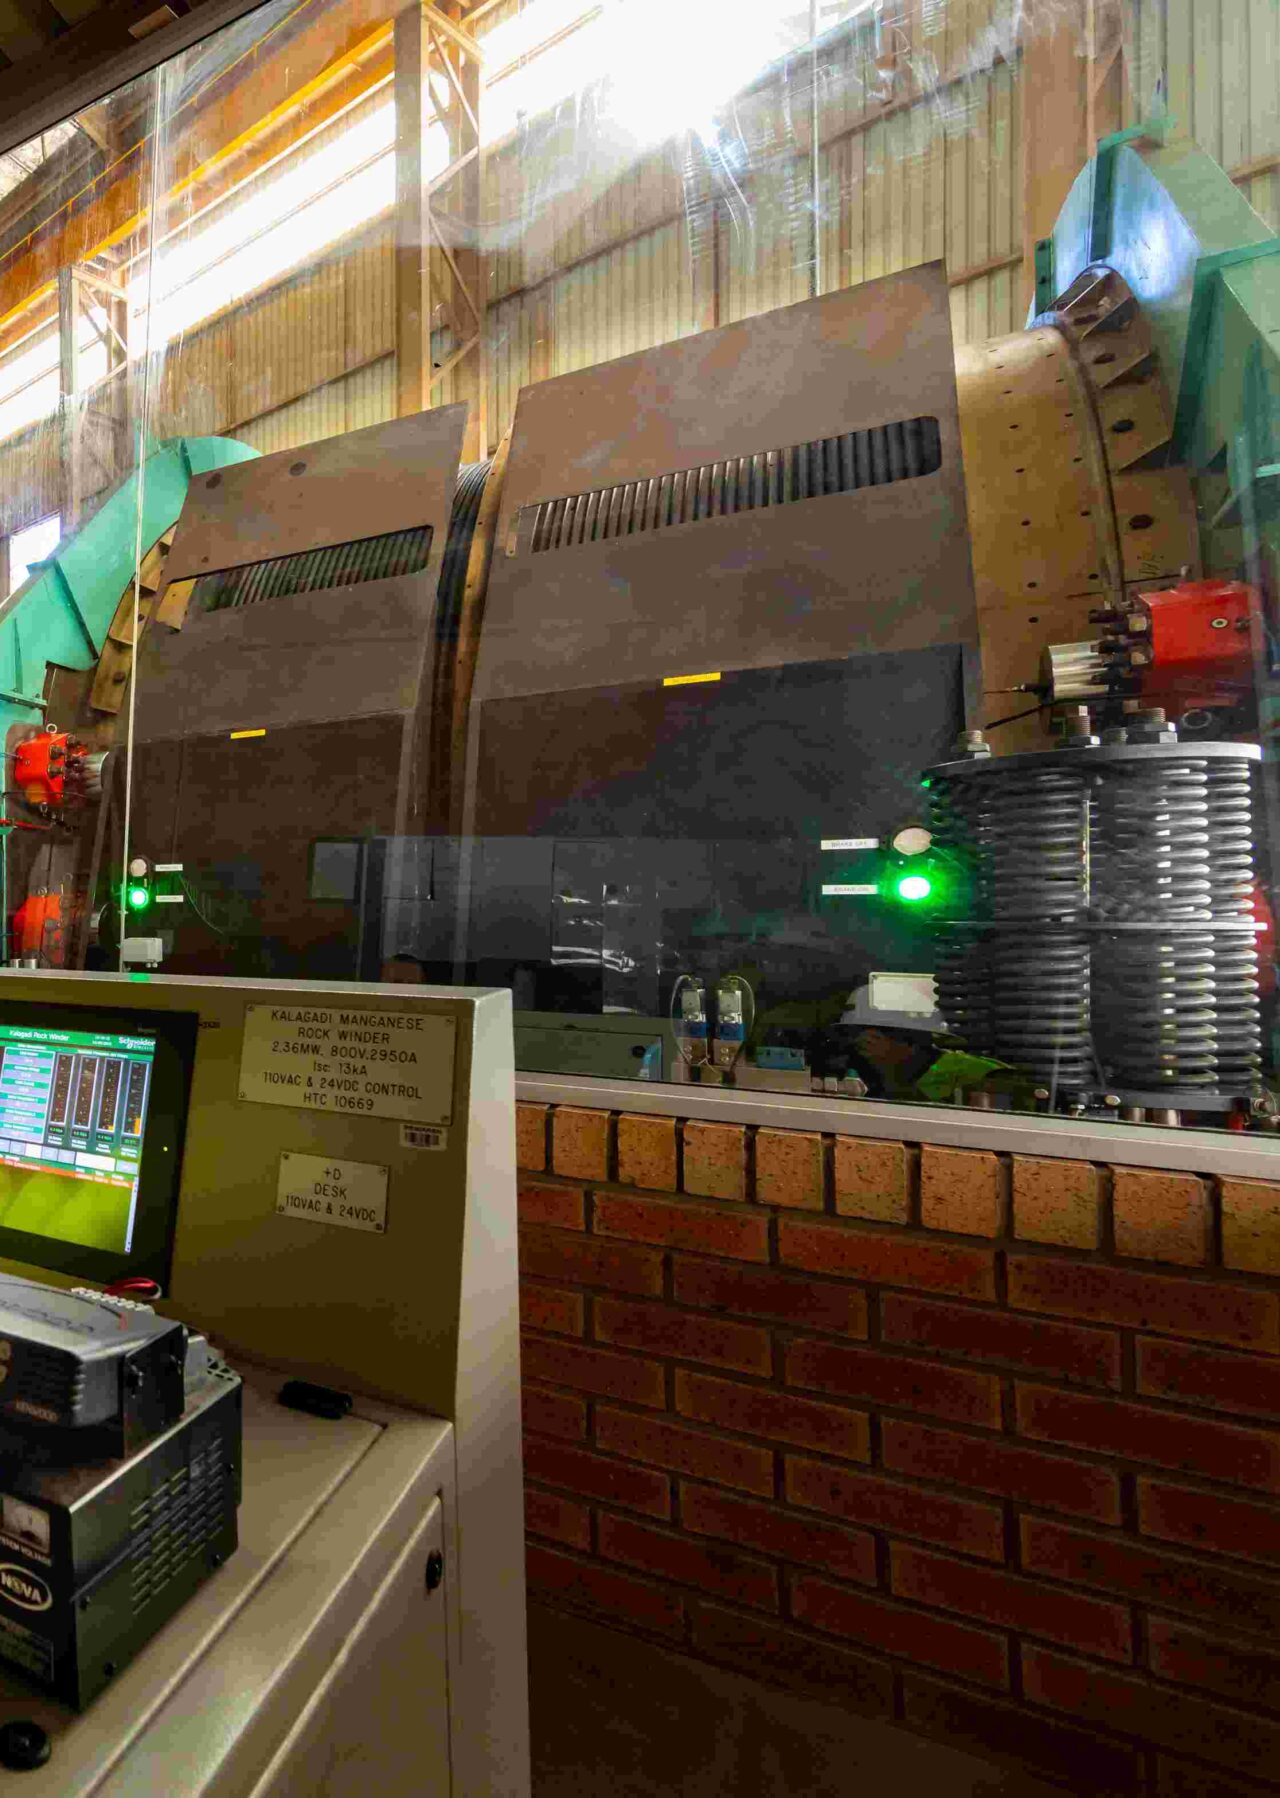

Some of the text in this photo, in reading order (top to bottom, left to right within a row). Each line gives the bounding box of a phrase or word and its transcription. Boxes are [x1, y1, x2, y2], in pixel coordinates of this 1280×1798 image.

[271, 1010, 424, 1031] KALAGADI MANGANESE
[298, 1027, 390, 1045] ROCK WINDER
[263, 1072, 423, 1099] 110VAC & 24VDC CONTROL
[304, 1092, 374, 1110] HTC 10669
[314, 1183, 347, 1199] DESK
[286, 1195, 321, 1212] 110VAC
[339, 1205, 376, 1222] 24VDC
